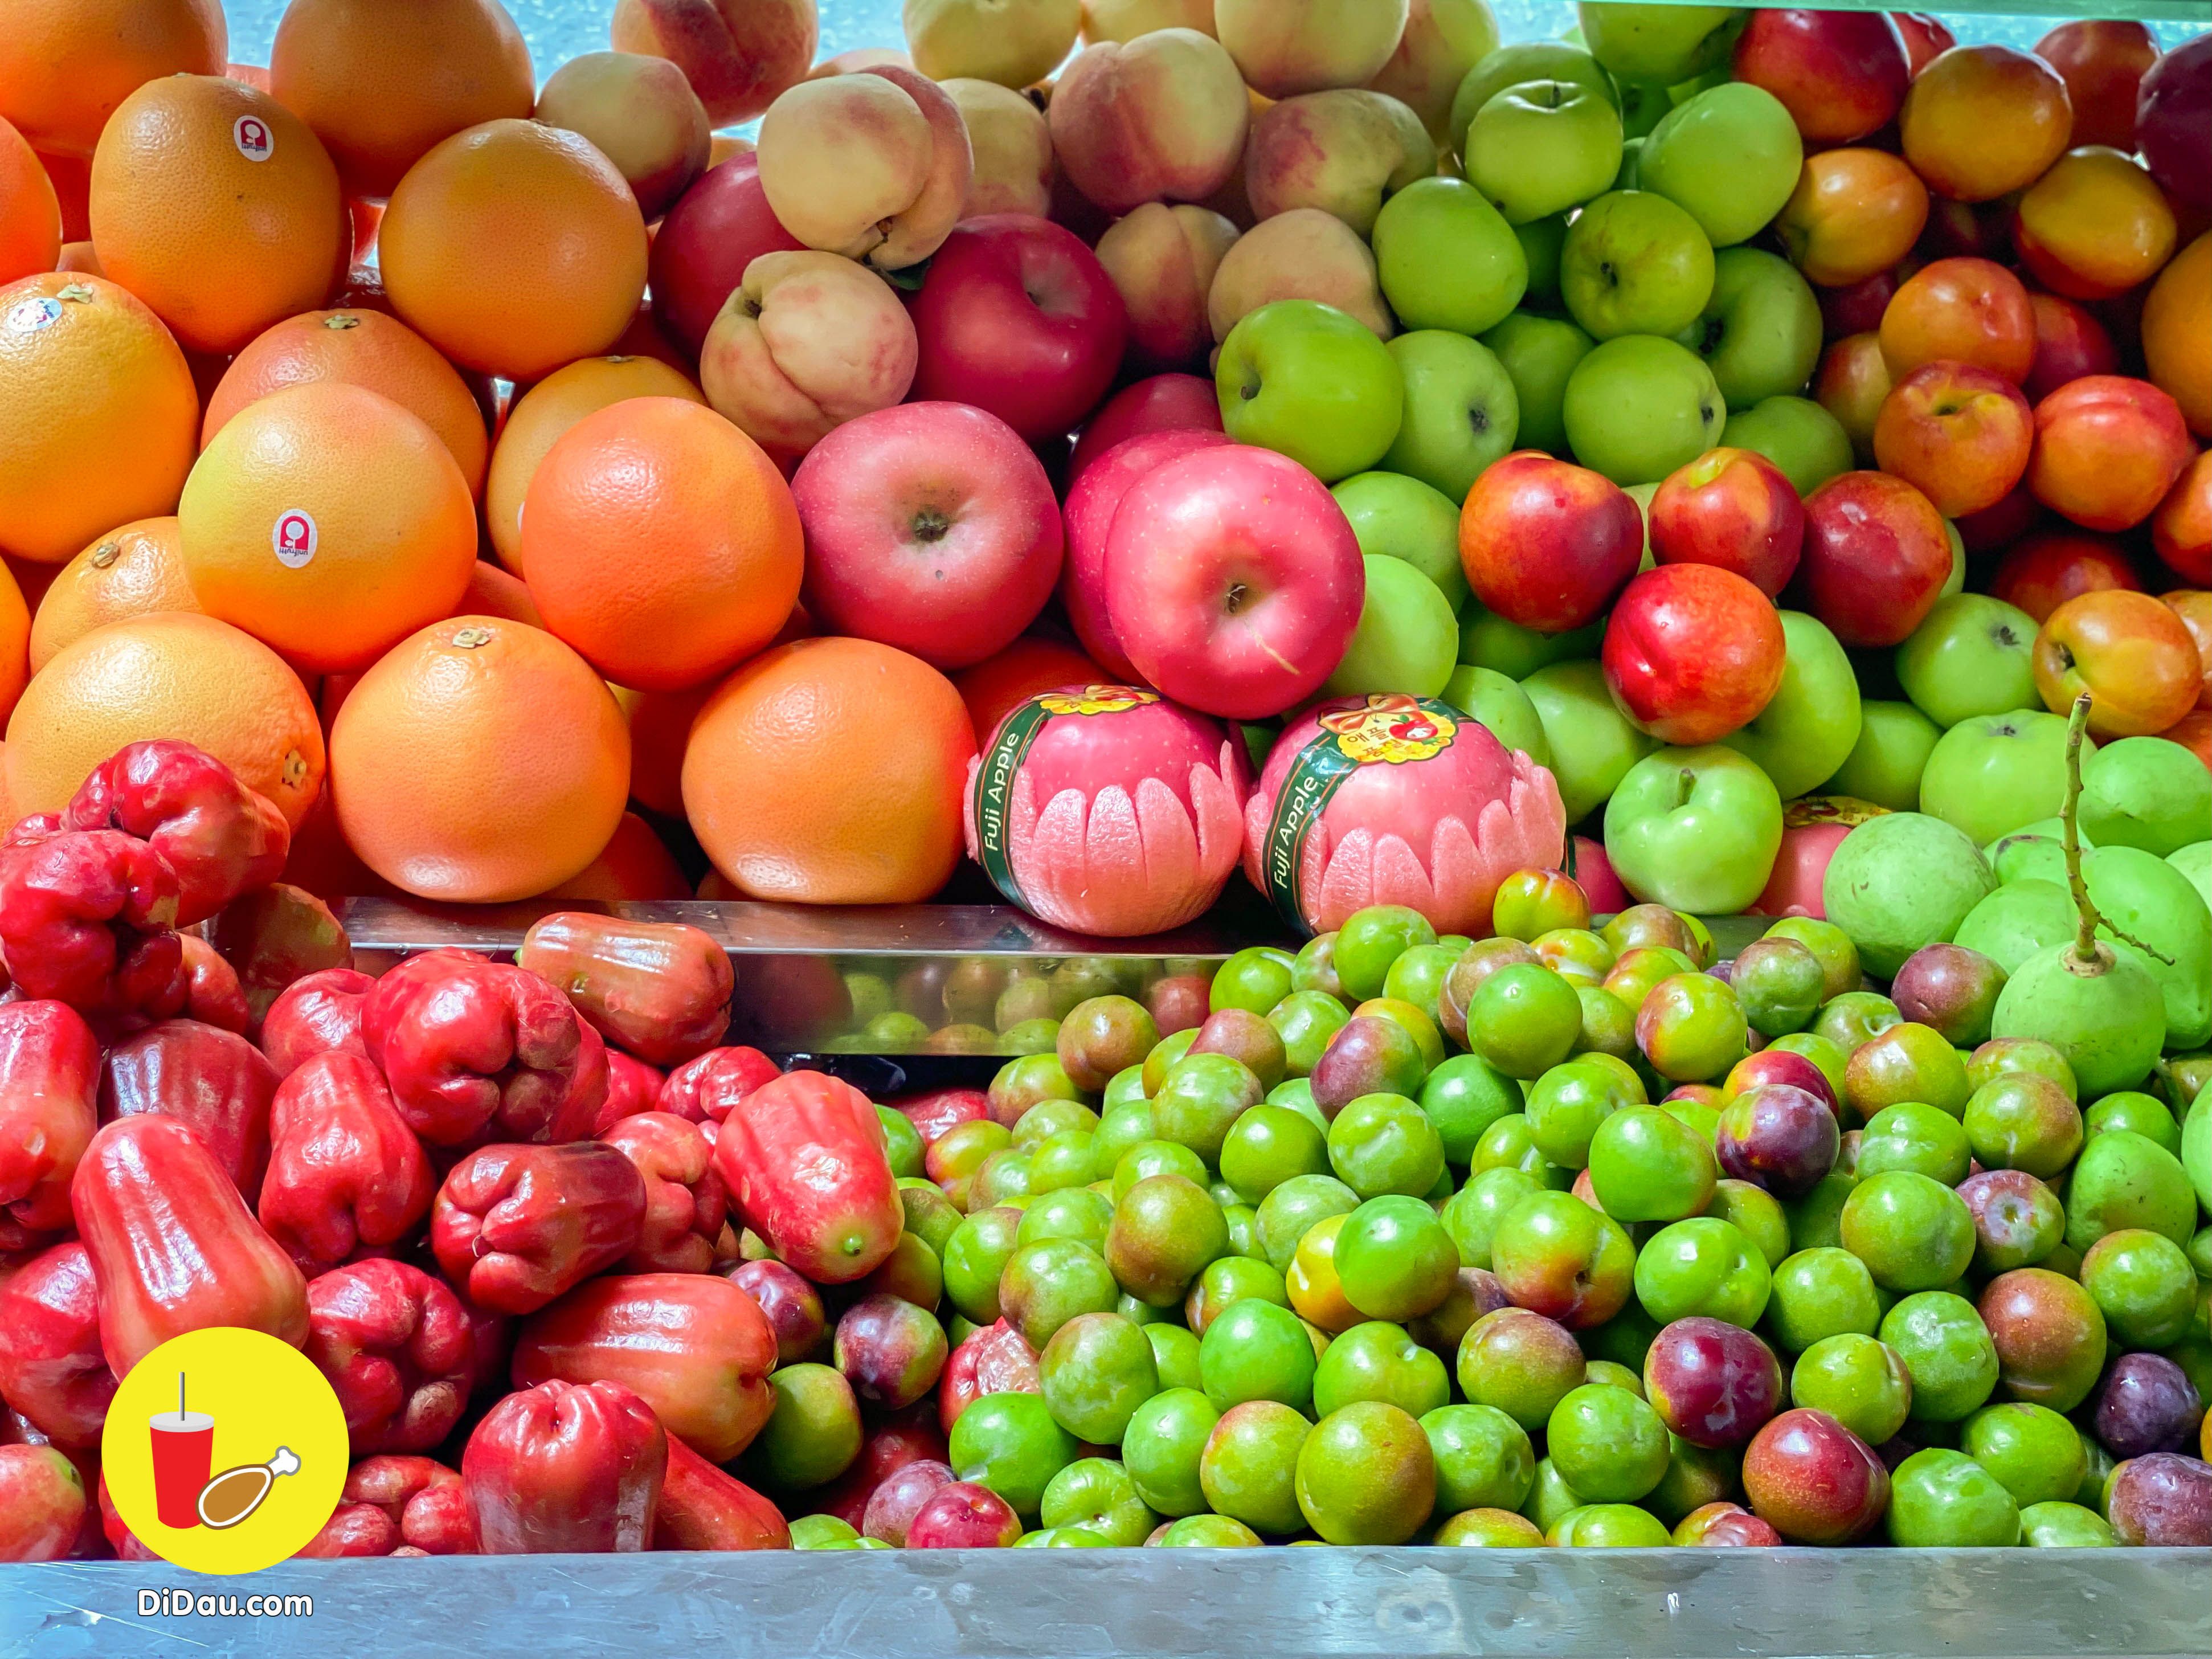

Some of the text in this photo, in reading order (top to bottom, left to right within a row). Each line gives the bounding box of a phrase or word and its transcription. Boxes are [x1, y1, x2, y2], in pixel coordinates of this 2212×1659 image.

[1347, 727, 1389, 742] 애플
[984, 733, 1019, 851] Fuji Apple
[1274, 777, 1318, 889] Fuji Apple
